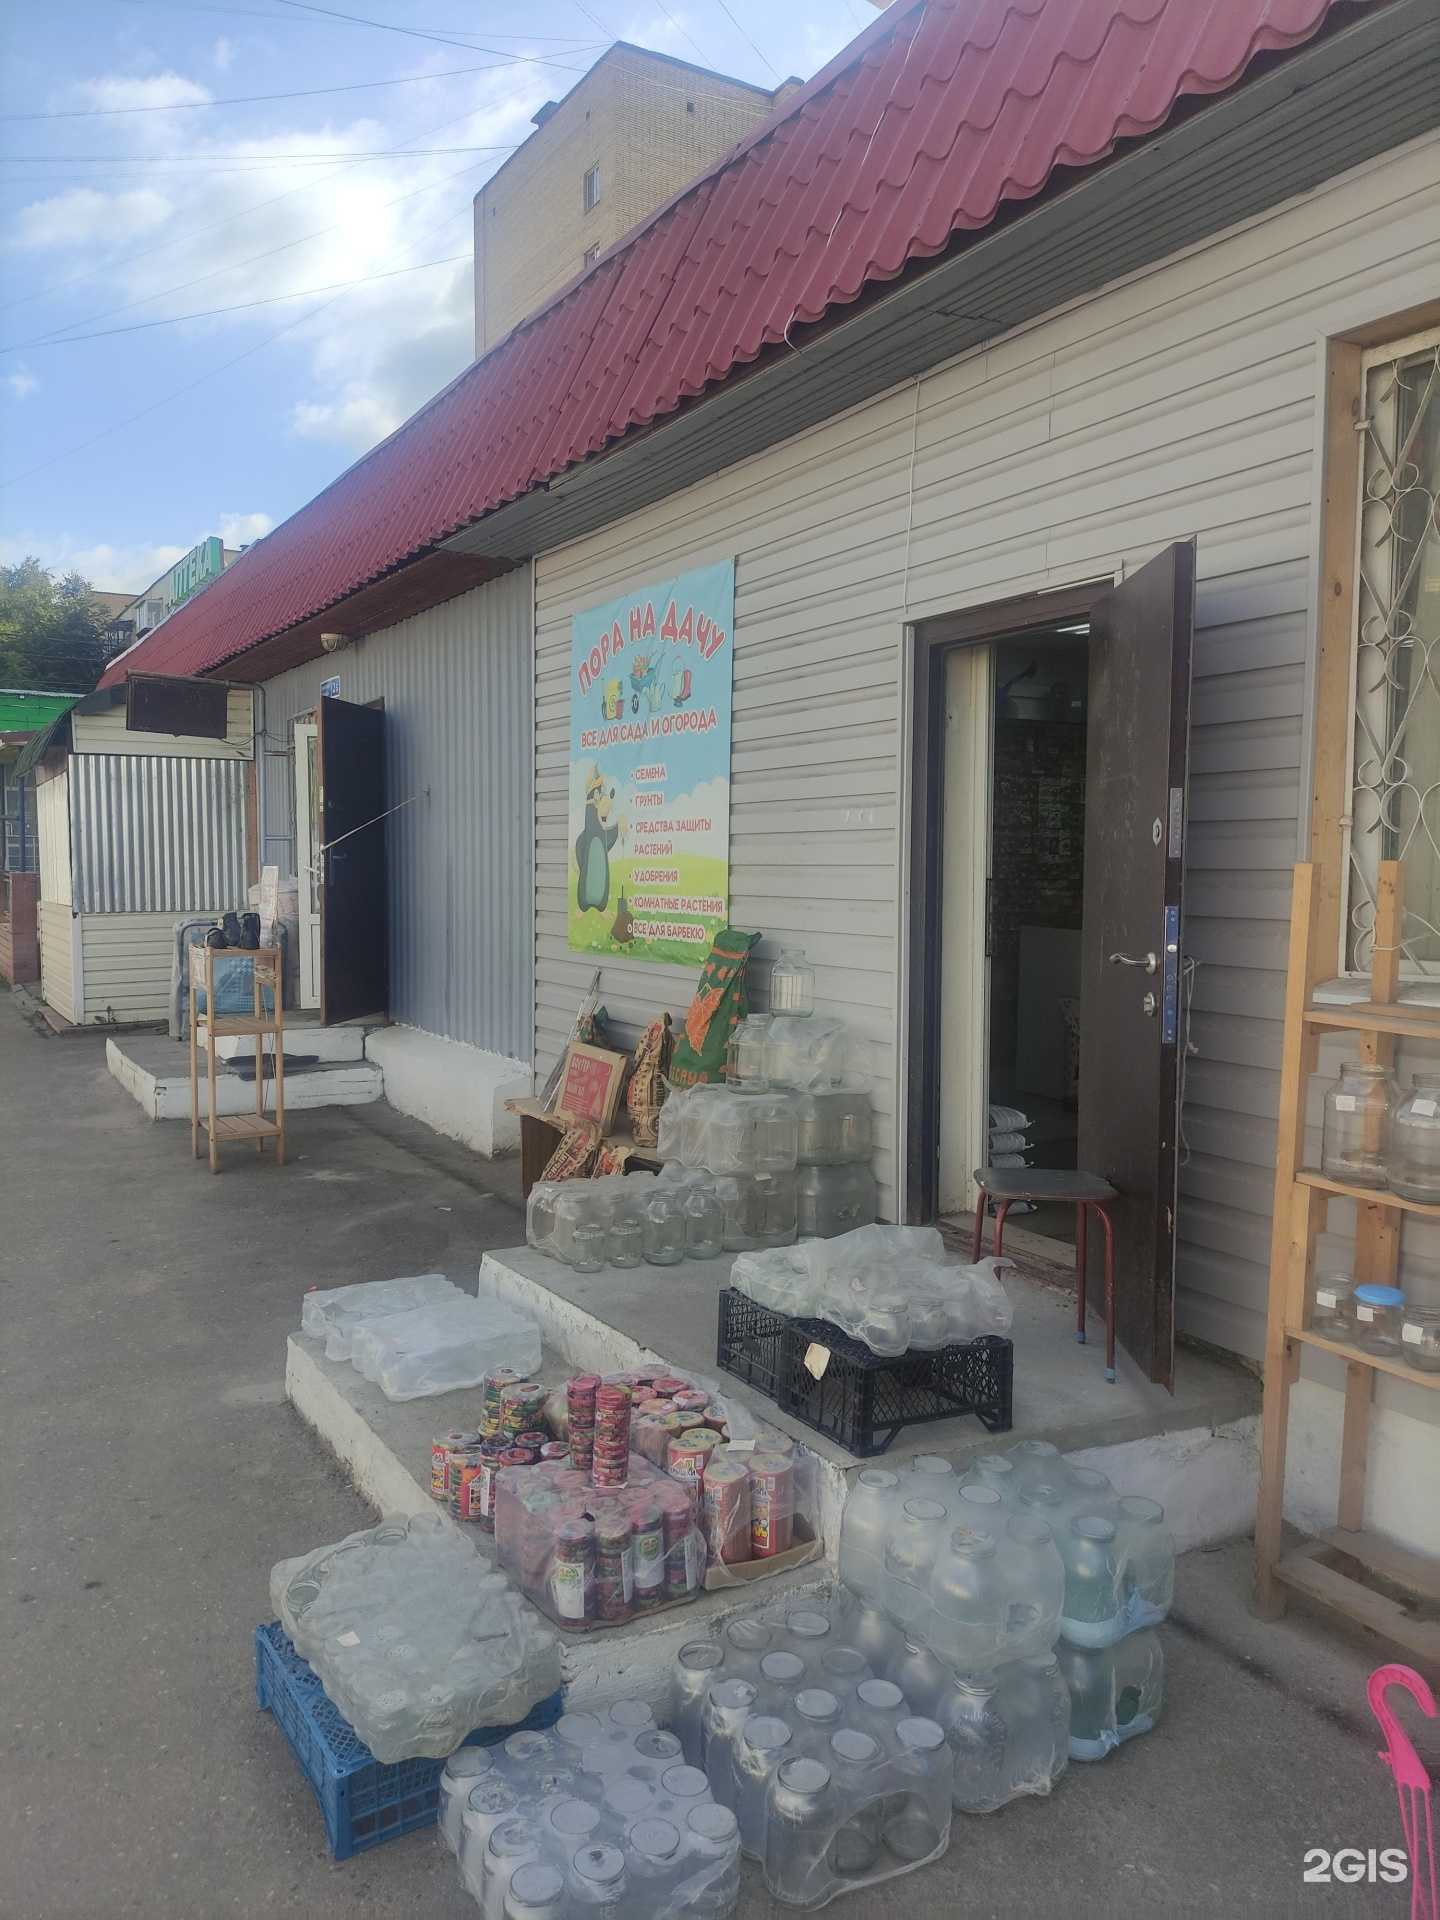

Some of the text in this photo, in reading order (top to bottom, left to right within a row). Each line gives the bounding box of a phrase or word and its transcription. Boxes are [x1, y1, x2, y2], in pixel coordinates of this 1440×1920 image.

[577, 601, 726, 695] ПОРА НА ДАЧУ
[581, 709, 717, 747] ВСЕ ДЛЯ САДА И ОГОРОДА
[635, 766, 666, 780] СЕМЕНА
[635, 793, 663, 807] ГРУНТЫ
[635, 818, 711, 834] СРЕДСТВА ЗАЩИТЫ
[634, 840, 673, 856] РАСТЕНИЙ
[633, 870, 678, 883] УДОБРЕНИЯ
[633, 898, 723, 913] КОМНАТНЫЕ РАСТЕНИЯ
[633, 923, 704, 940] ВСЕ ДЛЯ БАРБЕКЮ
